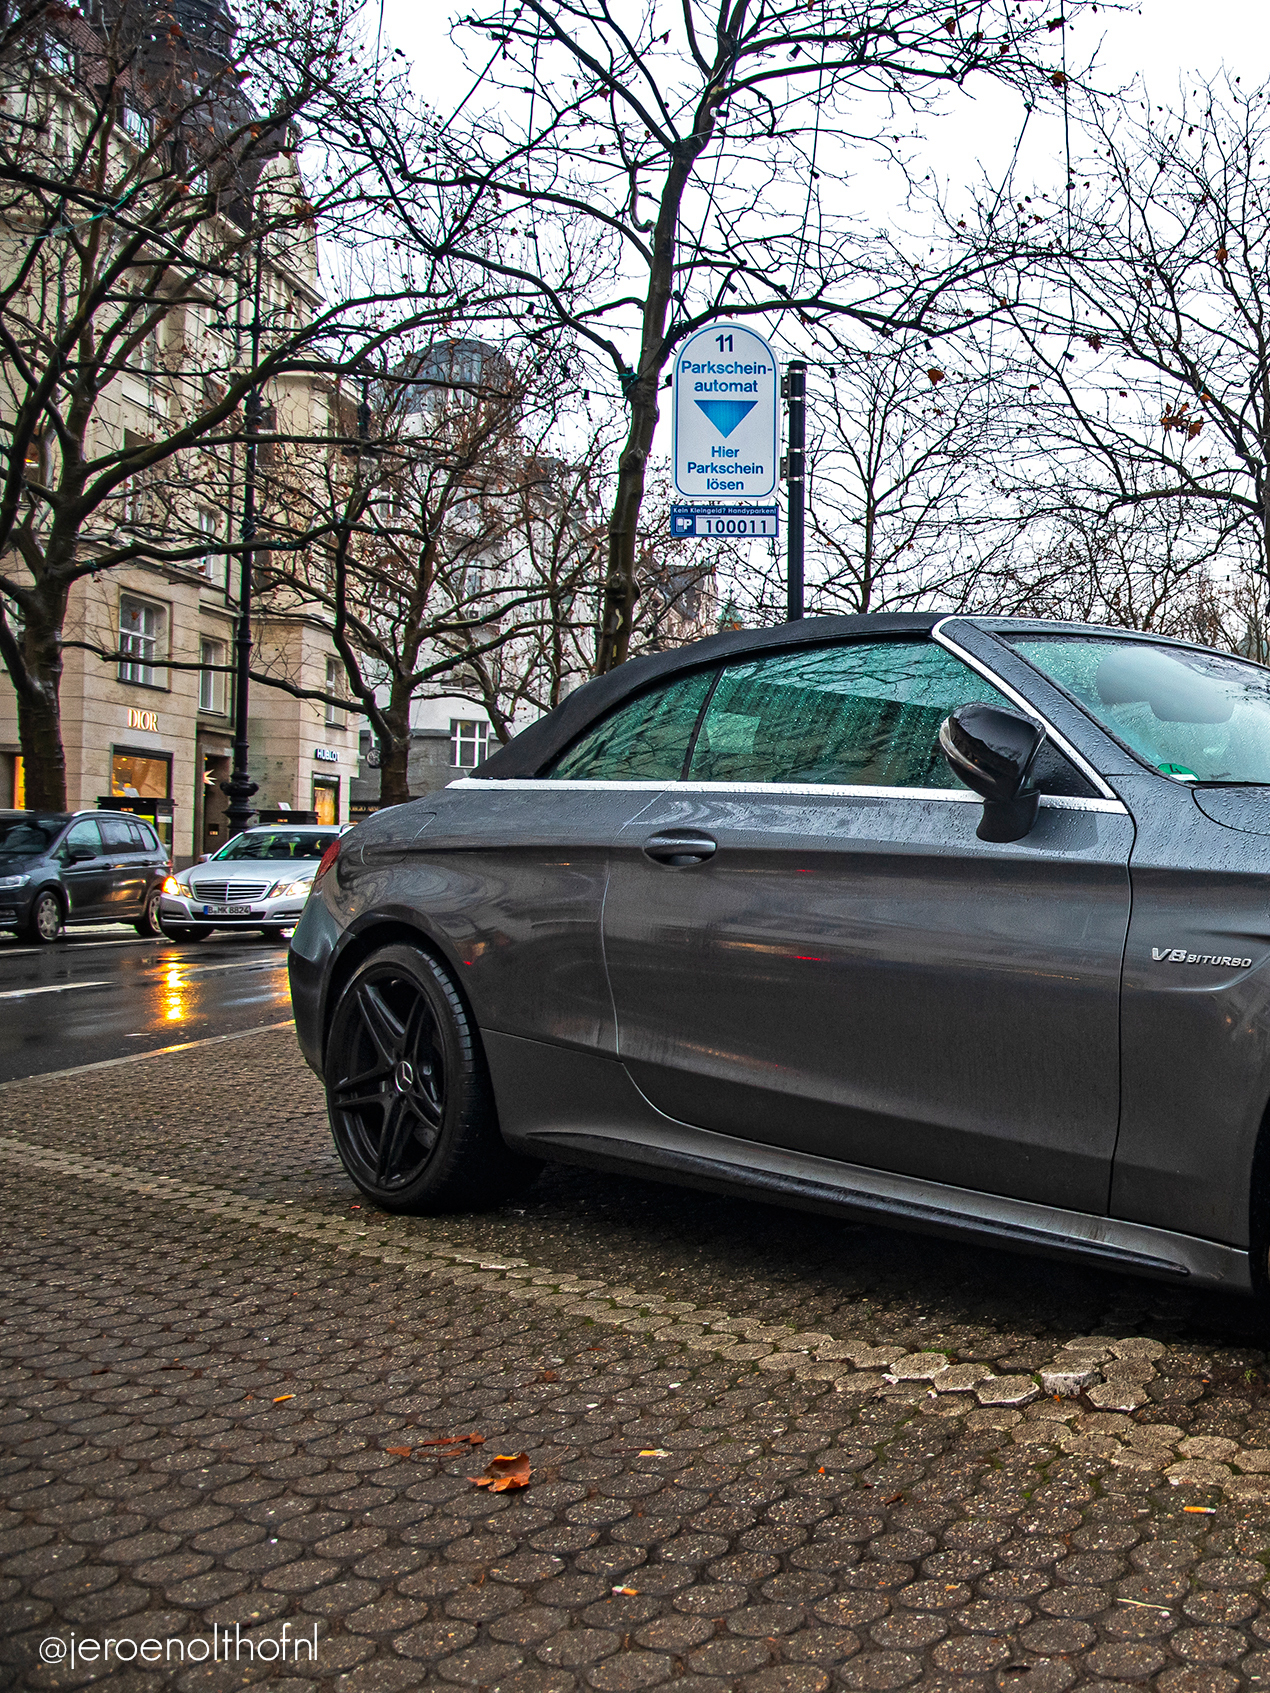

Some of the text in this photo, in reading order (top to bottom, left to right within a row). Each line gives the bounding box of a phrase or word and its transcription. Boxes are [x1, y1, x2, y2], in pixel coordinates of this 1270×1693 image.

[715, 334, 733, 352] 11
[681, 360, 773, 375] Parkschein-
[694, 379, 758, 393] automat
[711, 446, 740, 458] Hier
[687, 461, 764, 474] Parkschein
[706, 478, 744, 490] lösen
[706, 520, 767, 534] 100011
[127, 708, 159, 732] DIOR
[316, 748, 341, 762] HUBLOT
[1152, 947, 1252, 967] V8 BITURBO
